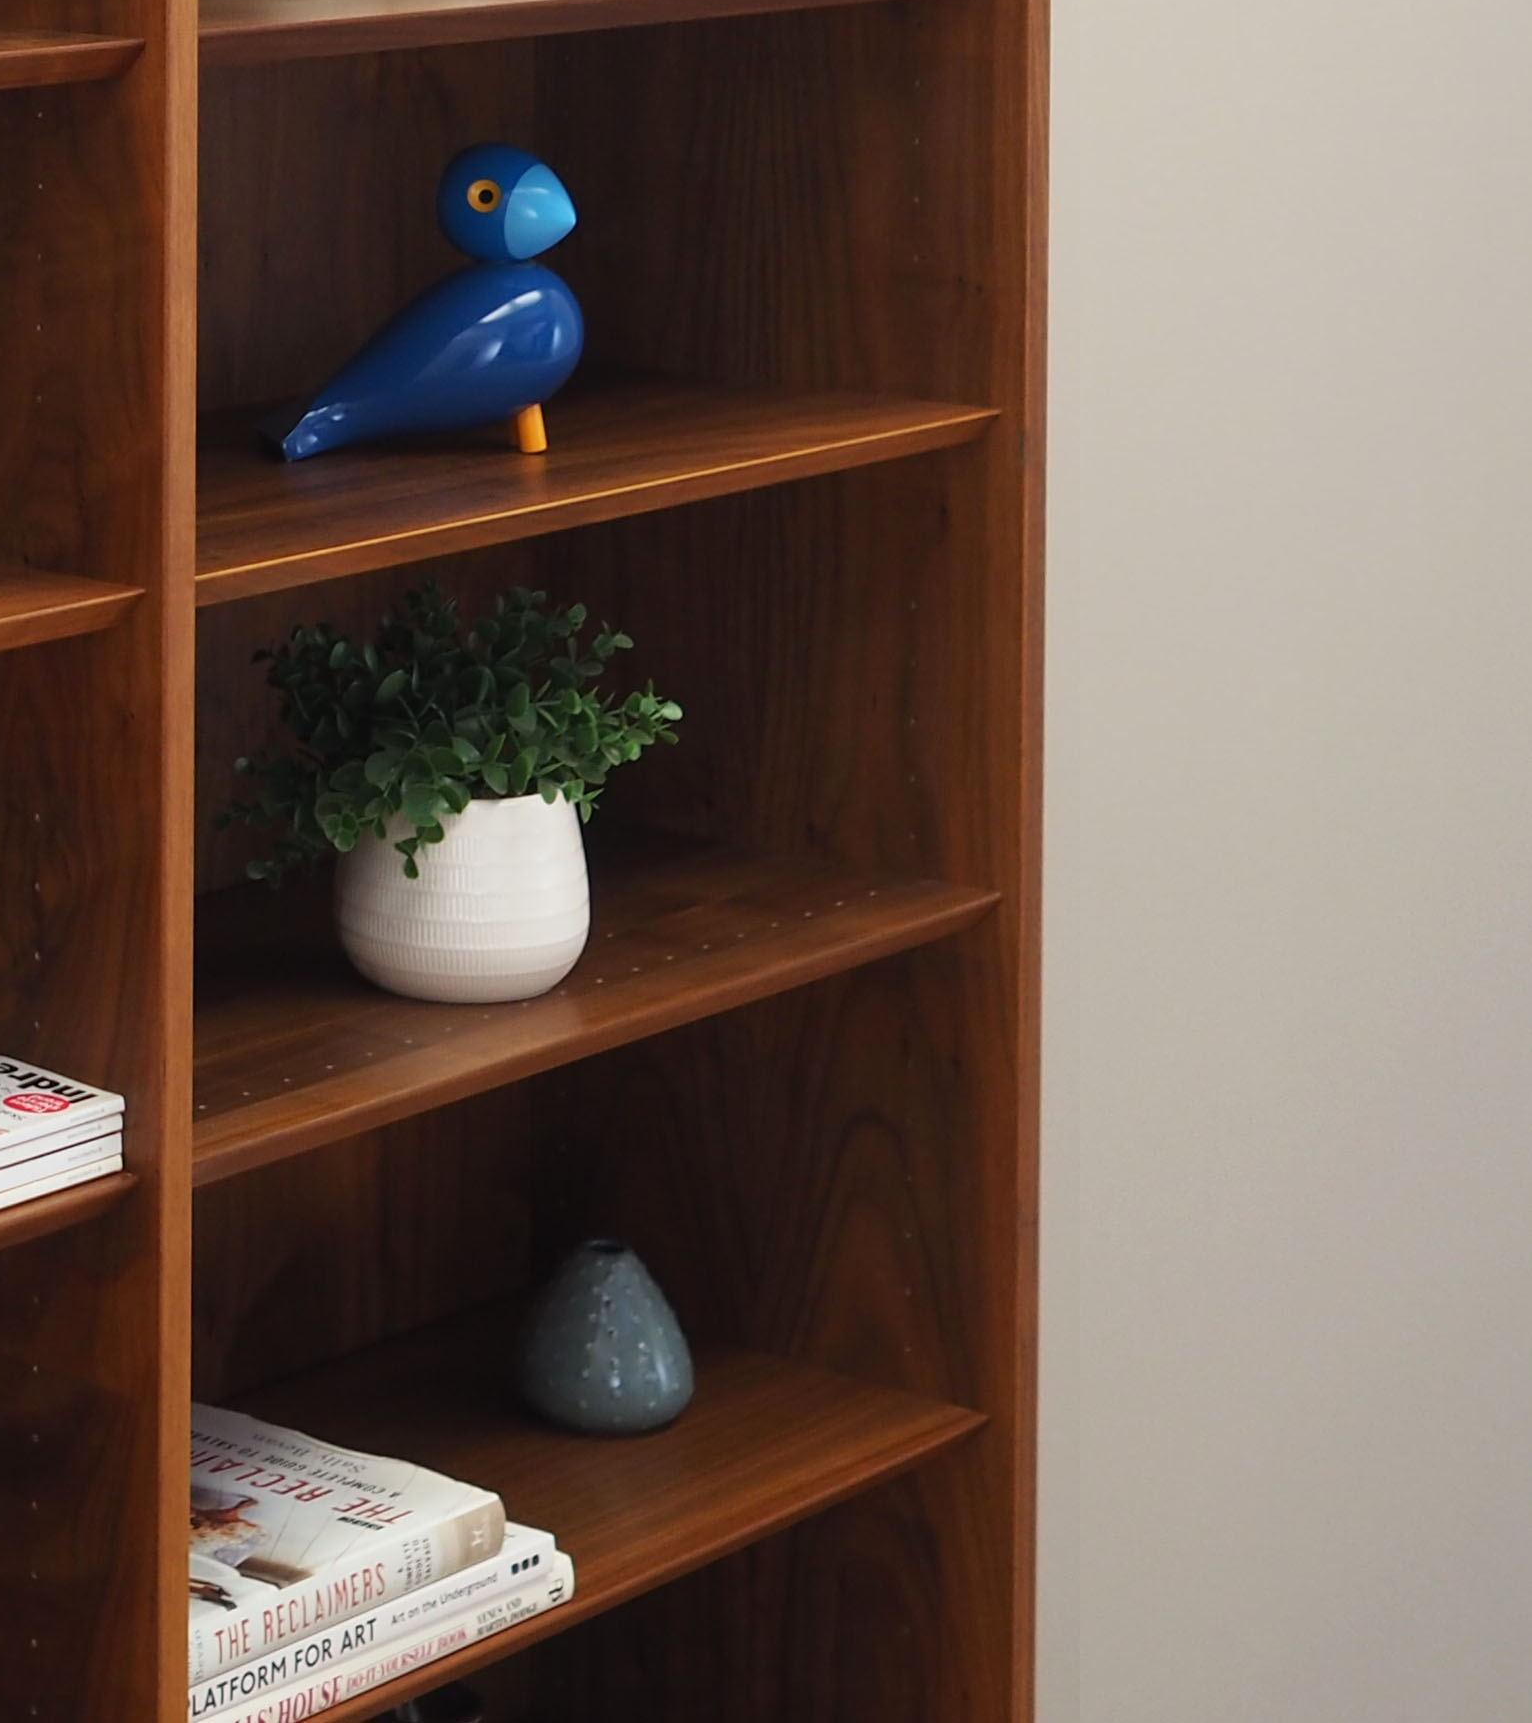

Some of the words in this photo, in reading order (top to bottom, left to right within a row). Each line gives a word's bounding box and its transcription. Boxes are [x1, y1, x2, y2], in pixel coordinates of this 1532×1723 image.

[332, 1497, 414, 1524] THE
[214, 1618, 252, 1664] THE
[262, 1562, 386, 1645] RECLAIMERS
[188, 1656, 287, 1717] LATFORM
[293, 1638, 333, 1674] FOR
[340, 1618, 377, 1655] ART
[278, 1675, 344, 1723] HOUSE
